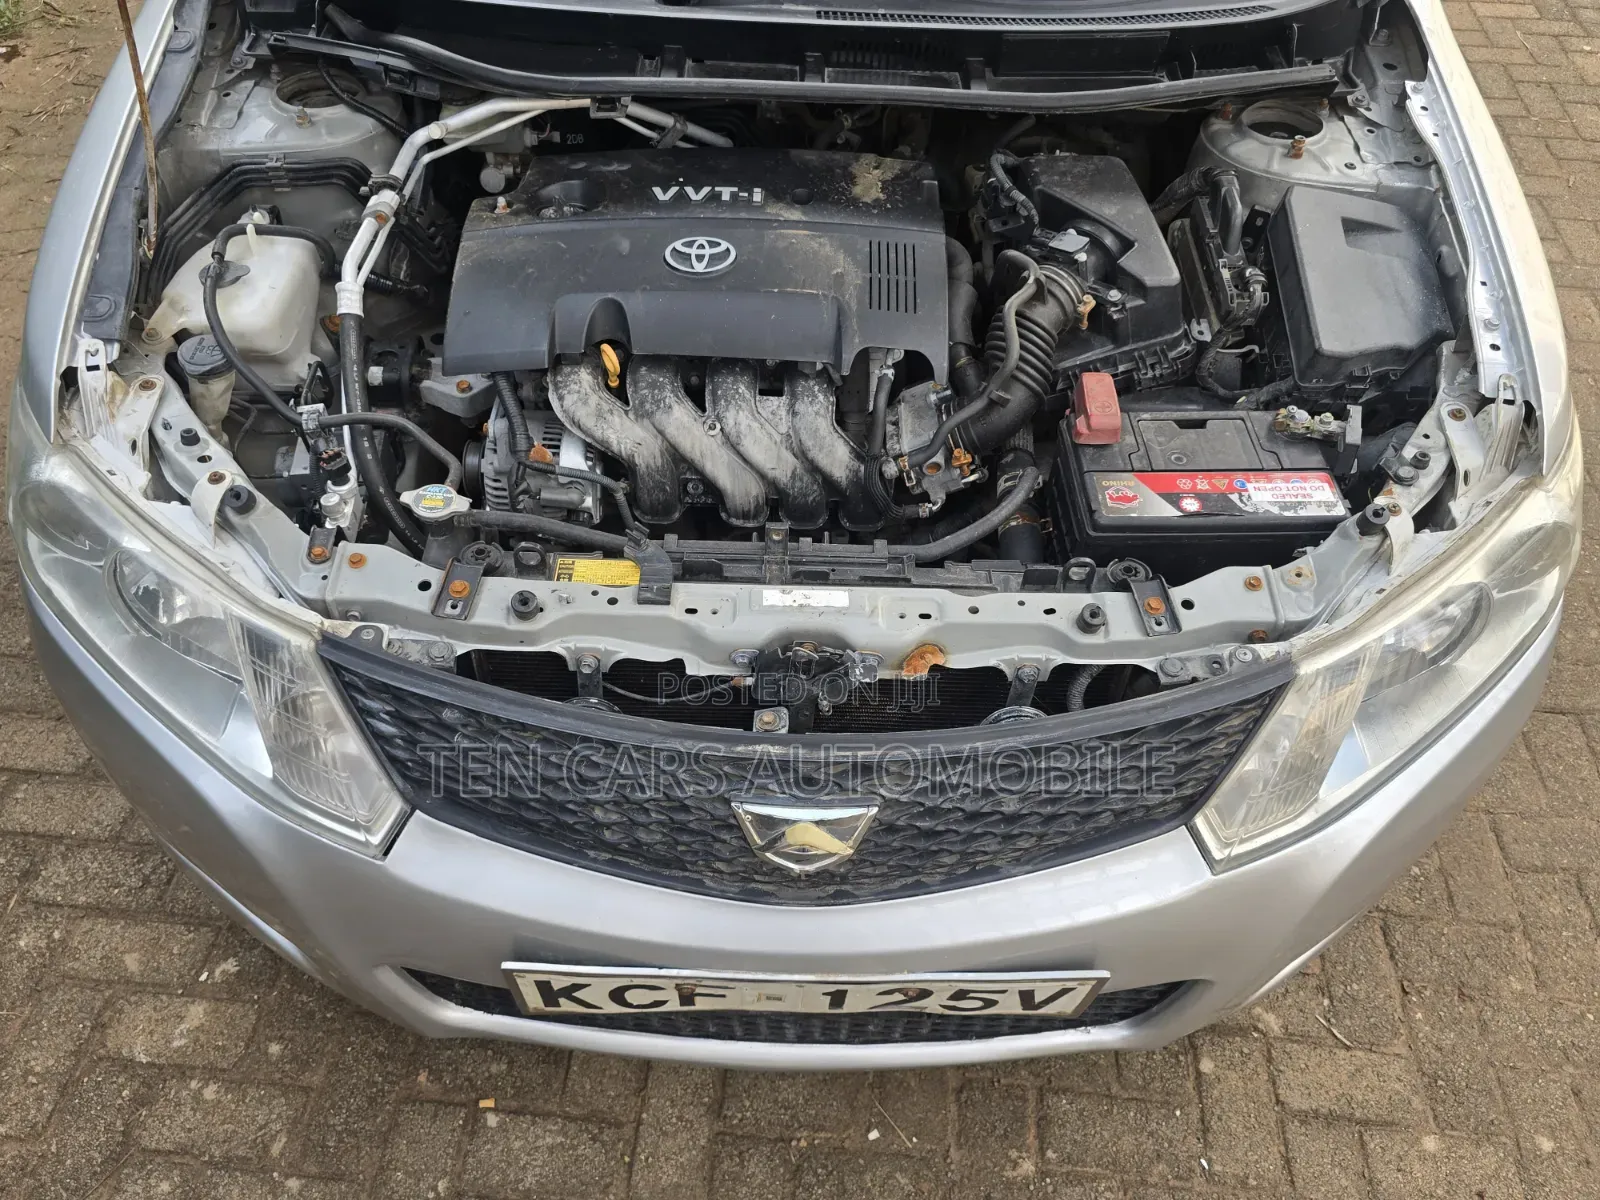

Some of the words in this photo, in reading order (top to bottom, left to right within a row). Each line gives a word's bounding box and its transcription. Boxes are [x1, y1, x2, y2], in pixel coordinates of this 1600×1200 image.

[651, 186, 763, 203] VVT-i
[1272, 492, 1313, 500] SEALED
[533, 979, 736, 1010] KCF
[821, 986, 1077, 1012] 125V
